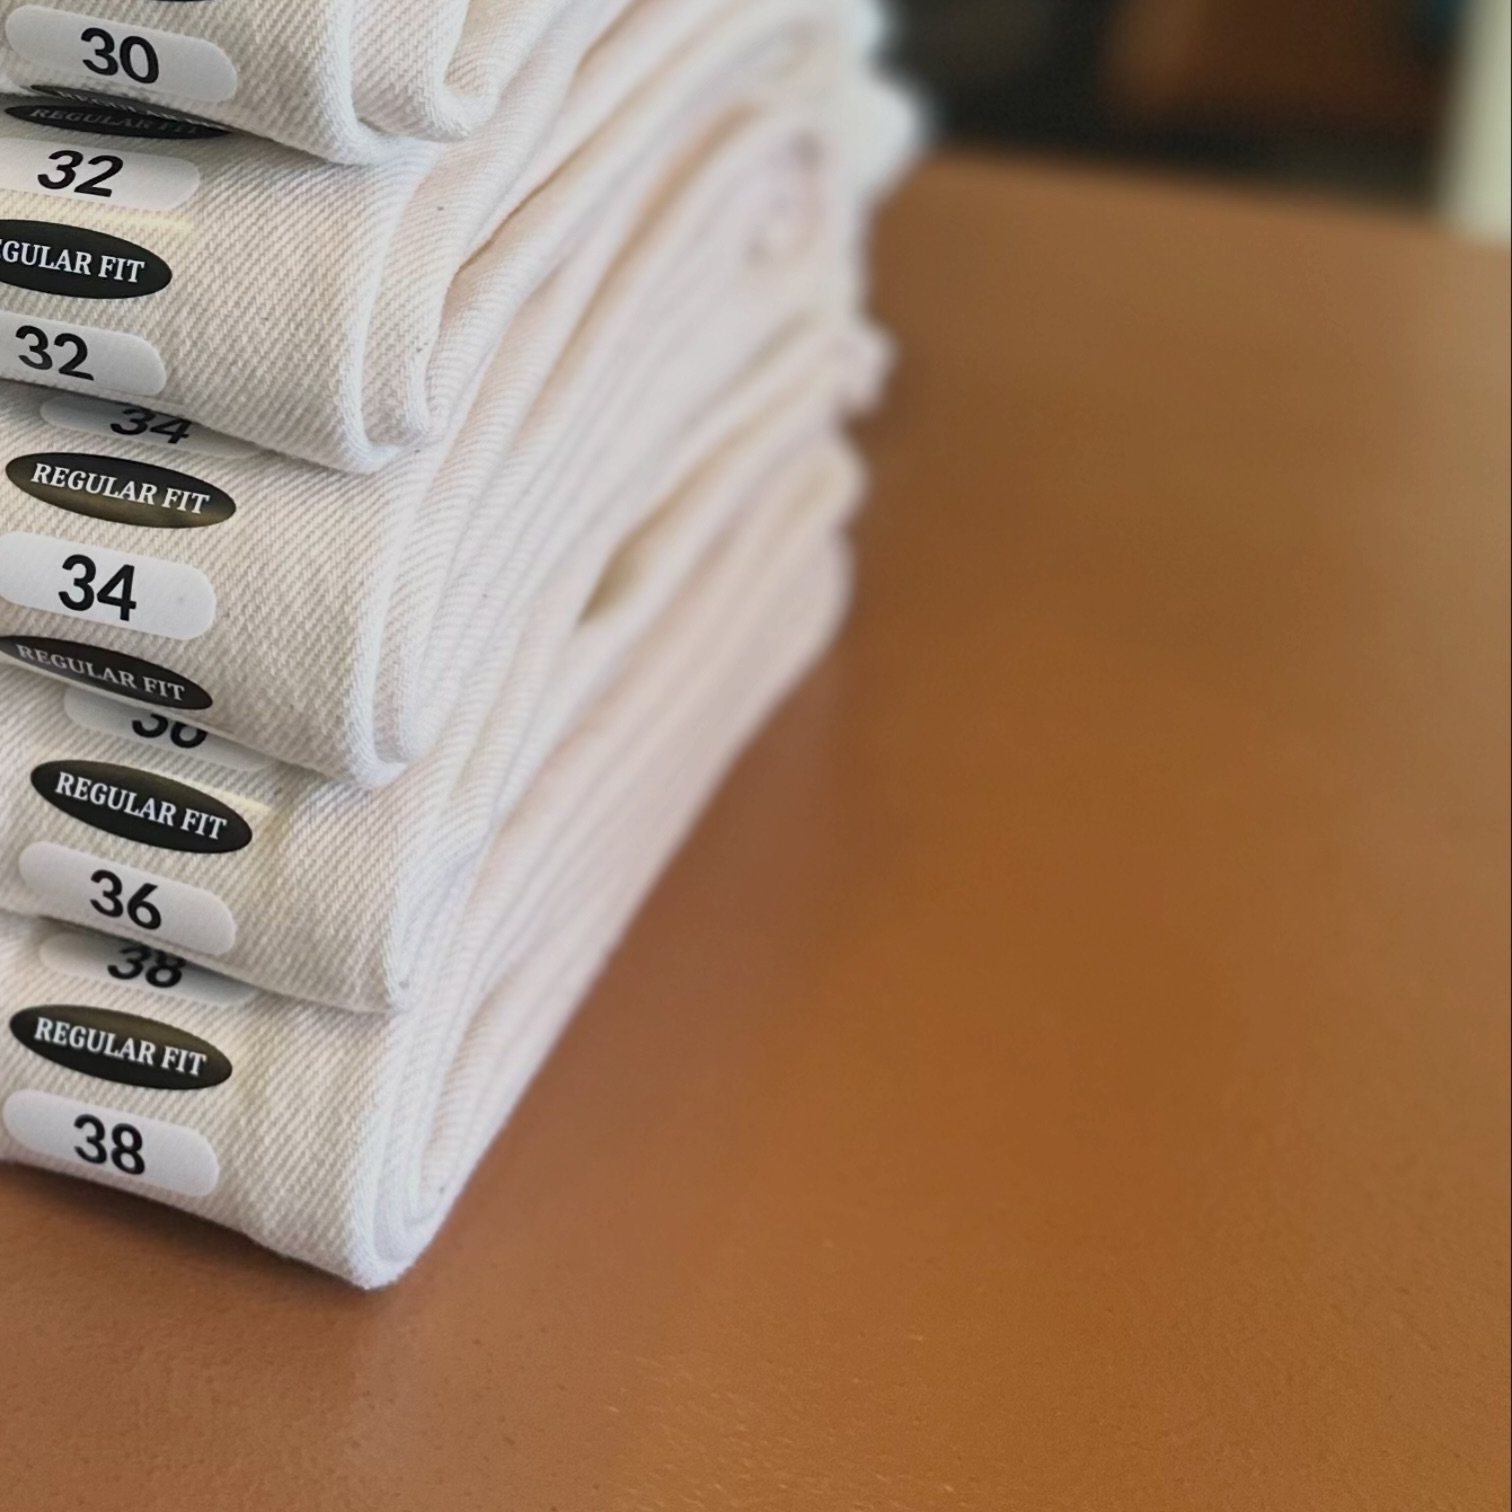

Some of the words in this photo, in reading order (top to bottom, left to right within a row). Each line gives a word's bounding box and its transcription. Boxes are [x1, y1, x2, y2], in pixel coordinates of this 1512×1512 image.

[80, 27, 159, 84] 30
[38, 150, 124, 197] 32
[99, 255, 145, 283] FIT
[15, 325, 95, 381] 32
[110, 407, 192, 444] 34
[31, 463, 156, 505] REGULAR
[161, 487, 210, 515] FIT
[58, 554, 137, 622] 34
[17, 644, 135, 689] REGULAR
[142, 678, 185, 701] FIT
[55, 771, 176, 826] REGULAR
[180, 810, 227, 841] FIT
[90, 869, 162, 930] 36
[108, 946, 187, 987] 38
[34, 1017, 156, 1065] REGULAR
[161, 1047, 208, 1077] FIT
[73, 1114, 146, 1175] 38
